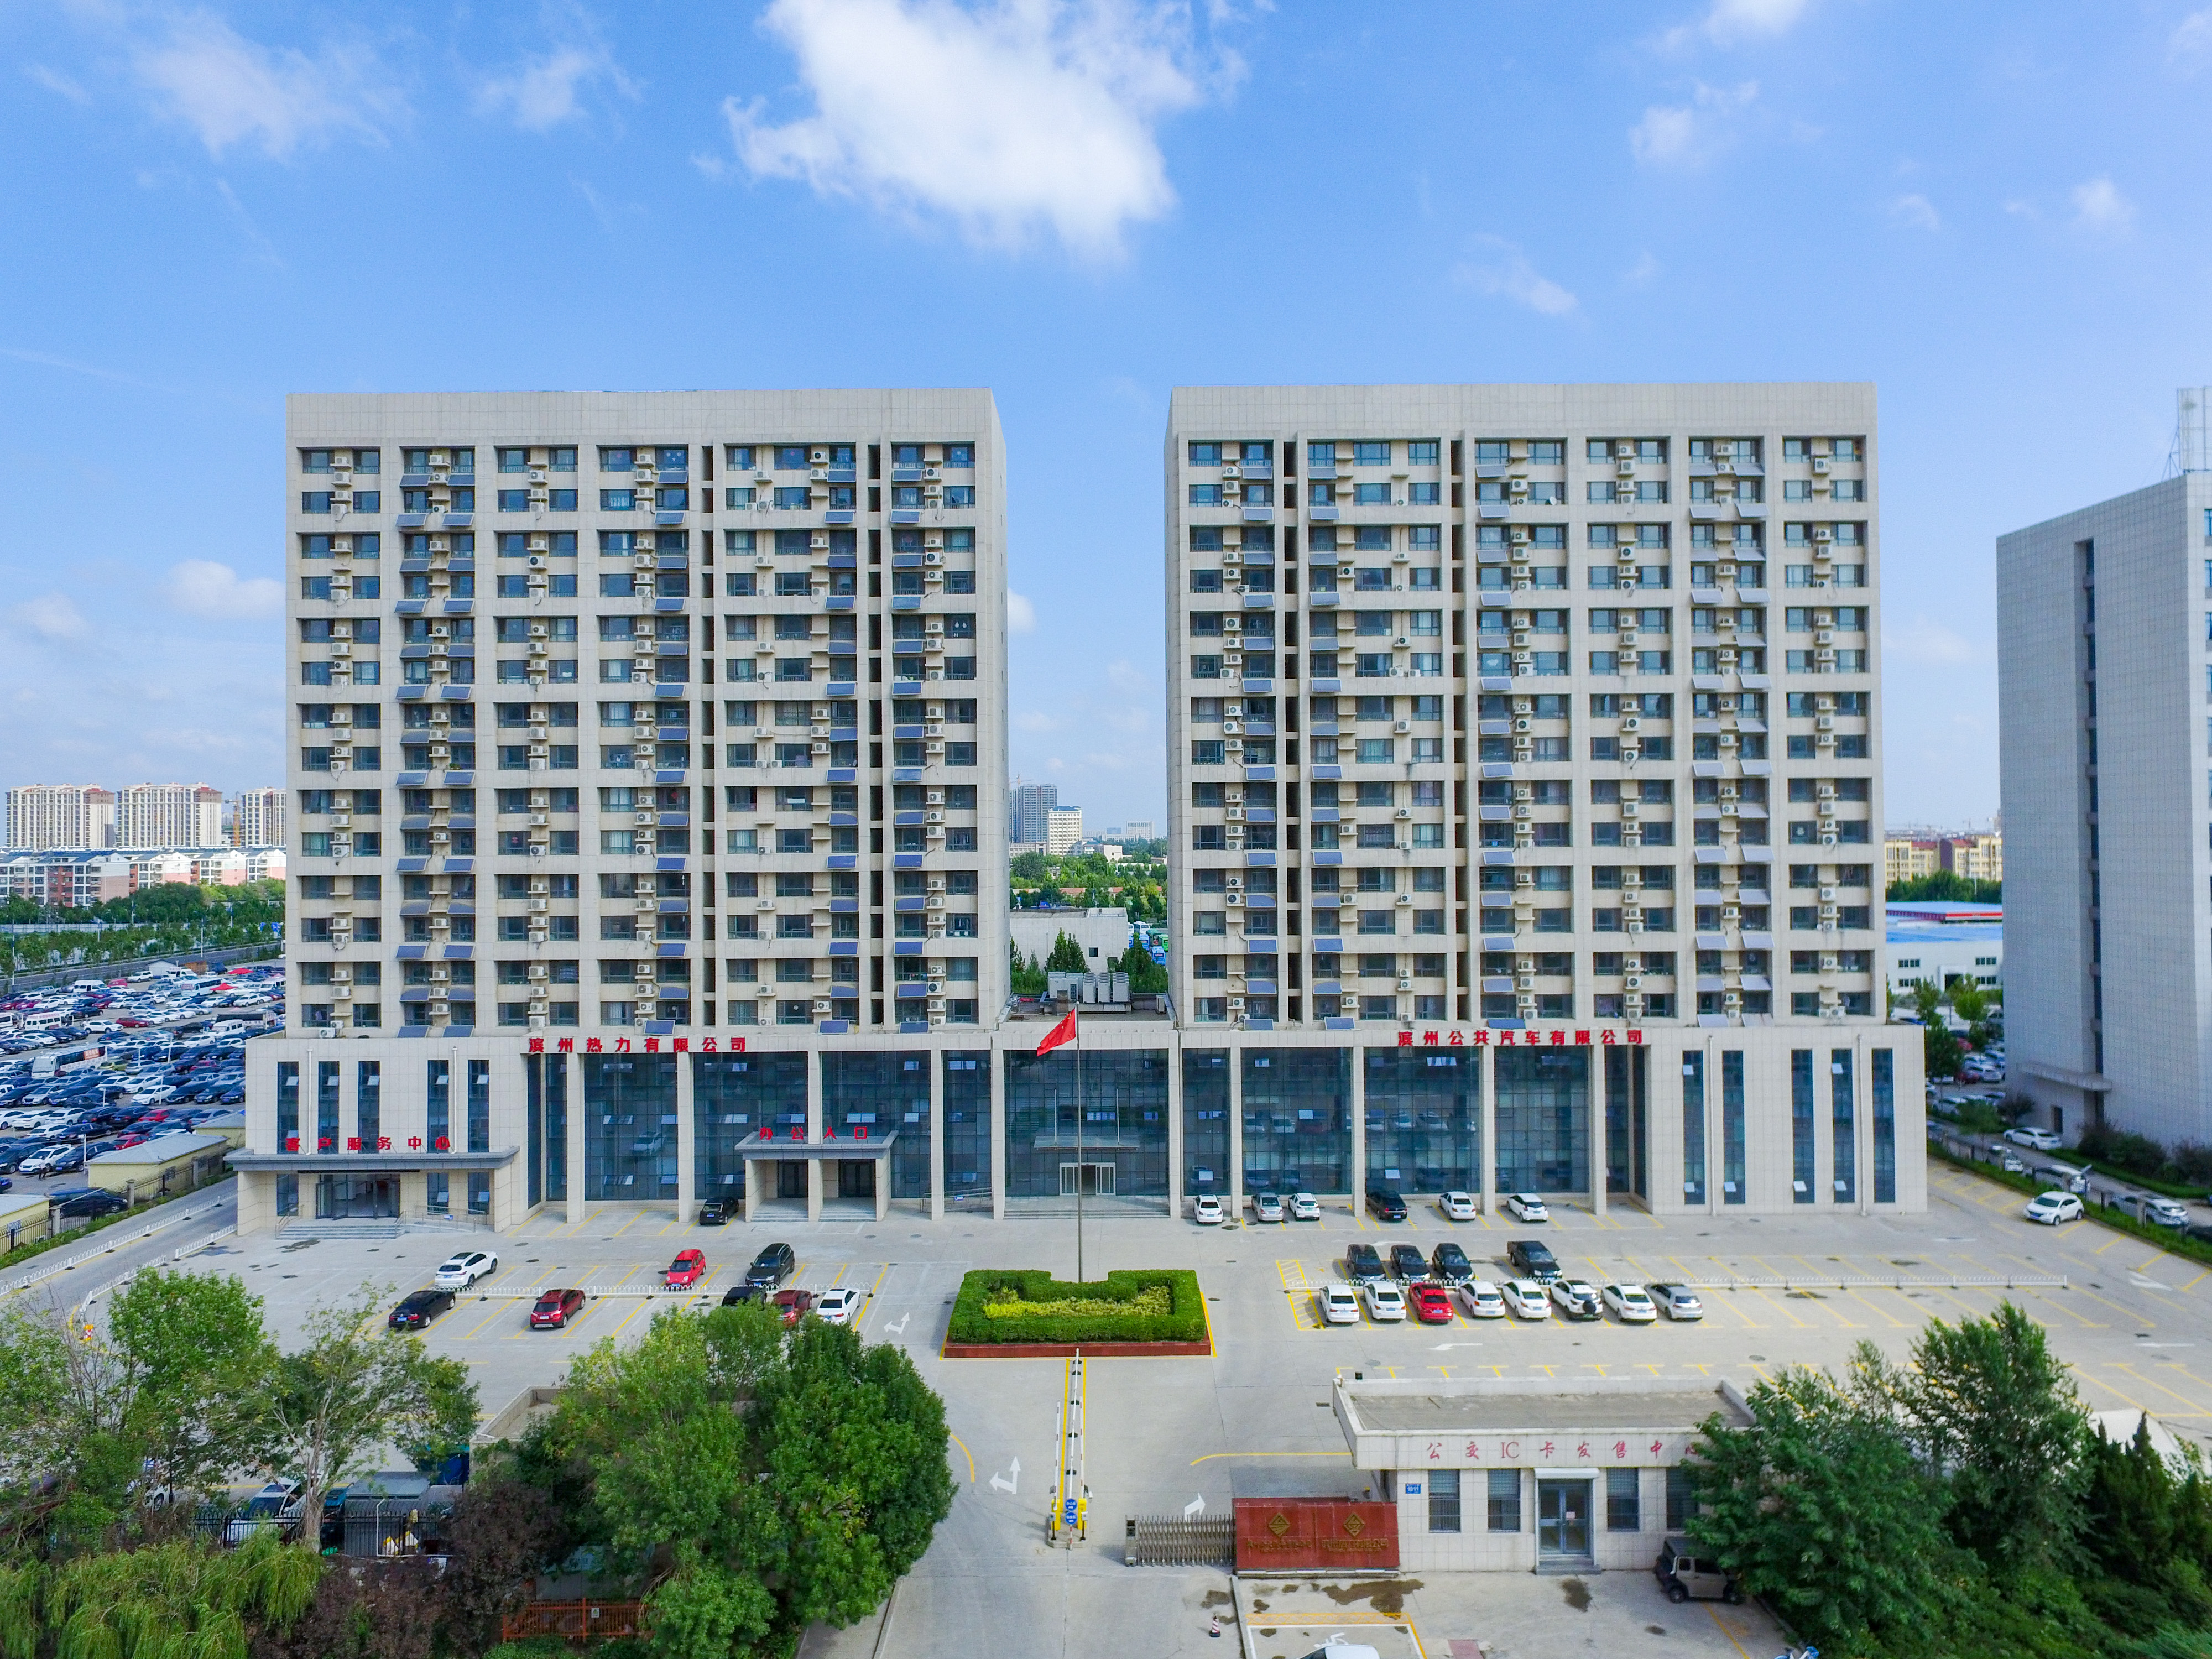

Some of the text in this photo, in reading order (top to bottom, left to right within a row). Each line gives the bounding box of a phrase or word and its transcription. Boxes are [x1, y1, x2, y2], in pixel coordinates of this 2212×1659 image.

[529, 1037, 745, 1052] 滨州热力有限公司
[1398, 1030, 1642, 1046] 滨州公共汽车有限公司
[759, 1126, 868, 1140] 办公入口
[286, 1136, 450, 1151] 客户服务中心
